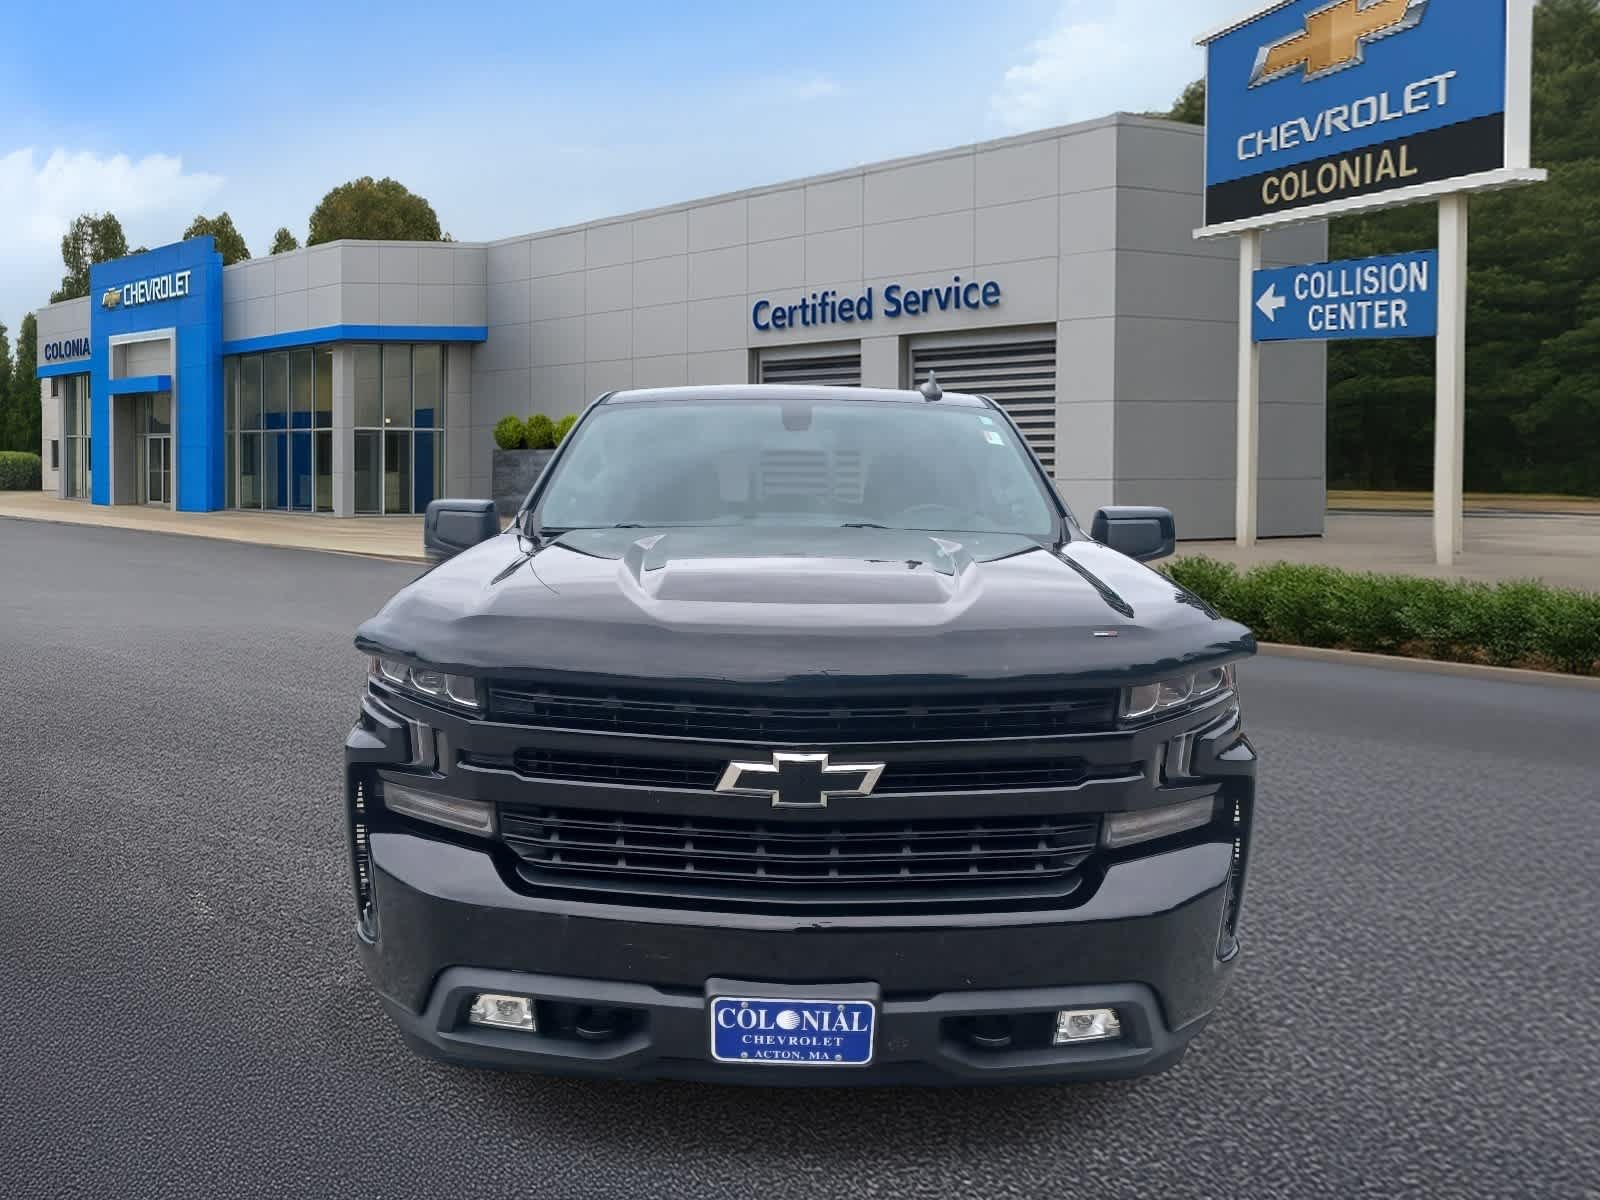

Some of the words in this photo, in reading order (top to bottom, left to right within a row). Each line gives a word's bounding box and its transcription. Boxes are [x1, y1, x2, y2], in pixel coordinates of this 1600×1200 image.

[1237, 70, 1457, 161] CHEVROLET
[1262, 145, 1418, 205] COLONIAL
[123, 270, 191, 306] CHEVROLET
[1294, 261, 1428, 300] COLLISION
[752, 287, 873, 330] Certified
[884, 276, 1001, 318] Service
[1308, 299, 1408, 331] CENTER
[717, 1007, 868, 1032] COLONIAL
[741, 1034, 844, 1047] CHEVROLET
[754, 1050, 805, 1061] ACTON,
[808, 1050, 830, 1060] MA
